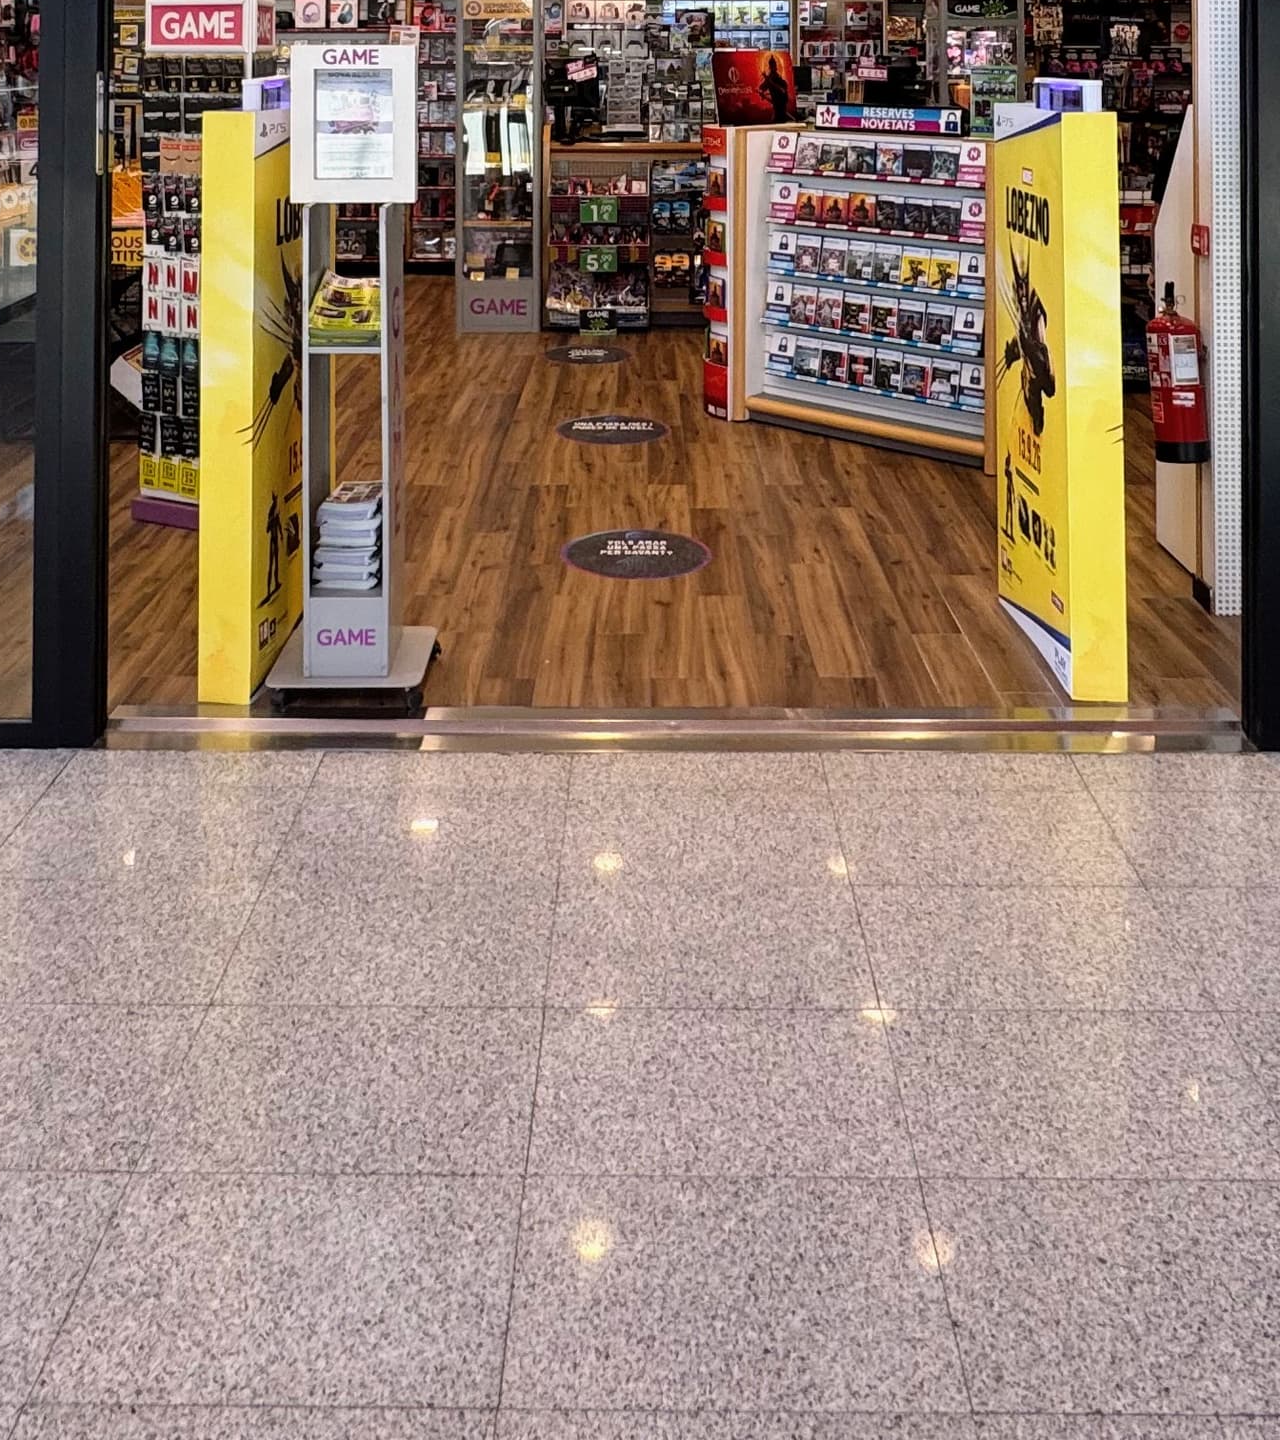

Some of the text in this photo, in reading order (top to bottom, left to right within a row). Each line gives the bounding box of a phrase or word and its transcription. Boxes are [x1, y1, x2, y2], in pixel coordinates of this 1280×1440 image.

[954, 4, 981, 14] GAME
[160, 10, 235, 40] GAME
[322, 48, 380, 65] GAME
[862, 107, 914, 120] RESERVES
[861, 118, 916, 131] NOVETATS
[1005, 185, 1050, 247] LOBEZNO
[112, 236, 143, 249] OUS
[113, 249, 144, 262] TITS
[586, 254, 599, 273] 5
[148, 261, 159, 286] N
[166, 264, 176, 289] N
[183, 270, 198, 295] N
[148, 296, 158, 320] N
[167, 303, 176, 328] N
[470, 297, 528, 316] GAME
[586, 310, 609, 319] GAME
[187, 305, 197, 329] N
[316, 628, 377, 647] GAME
